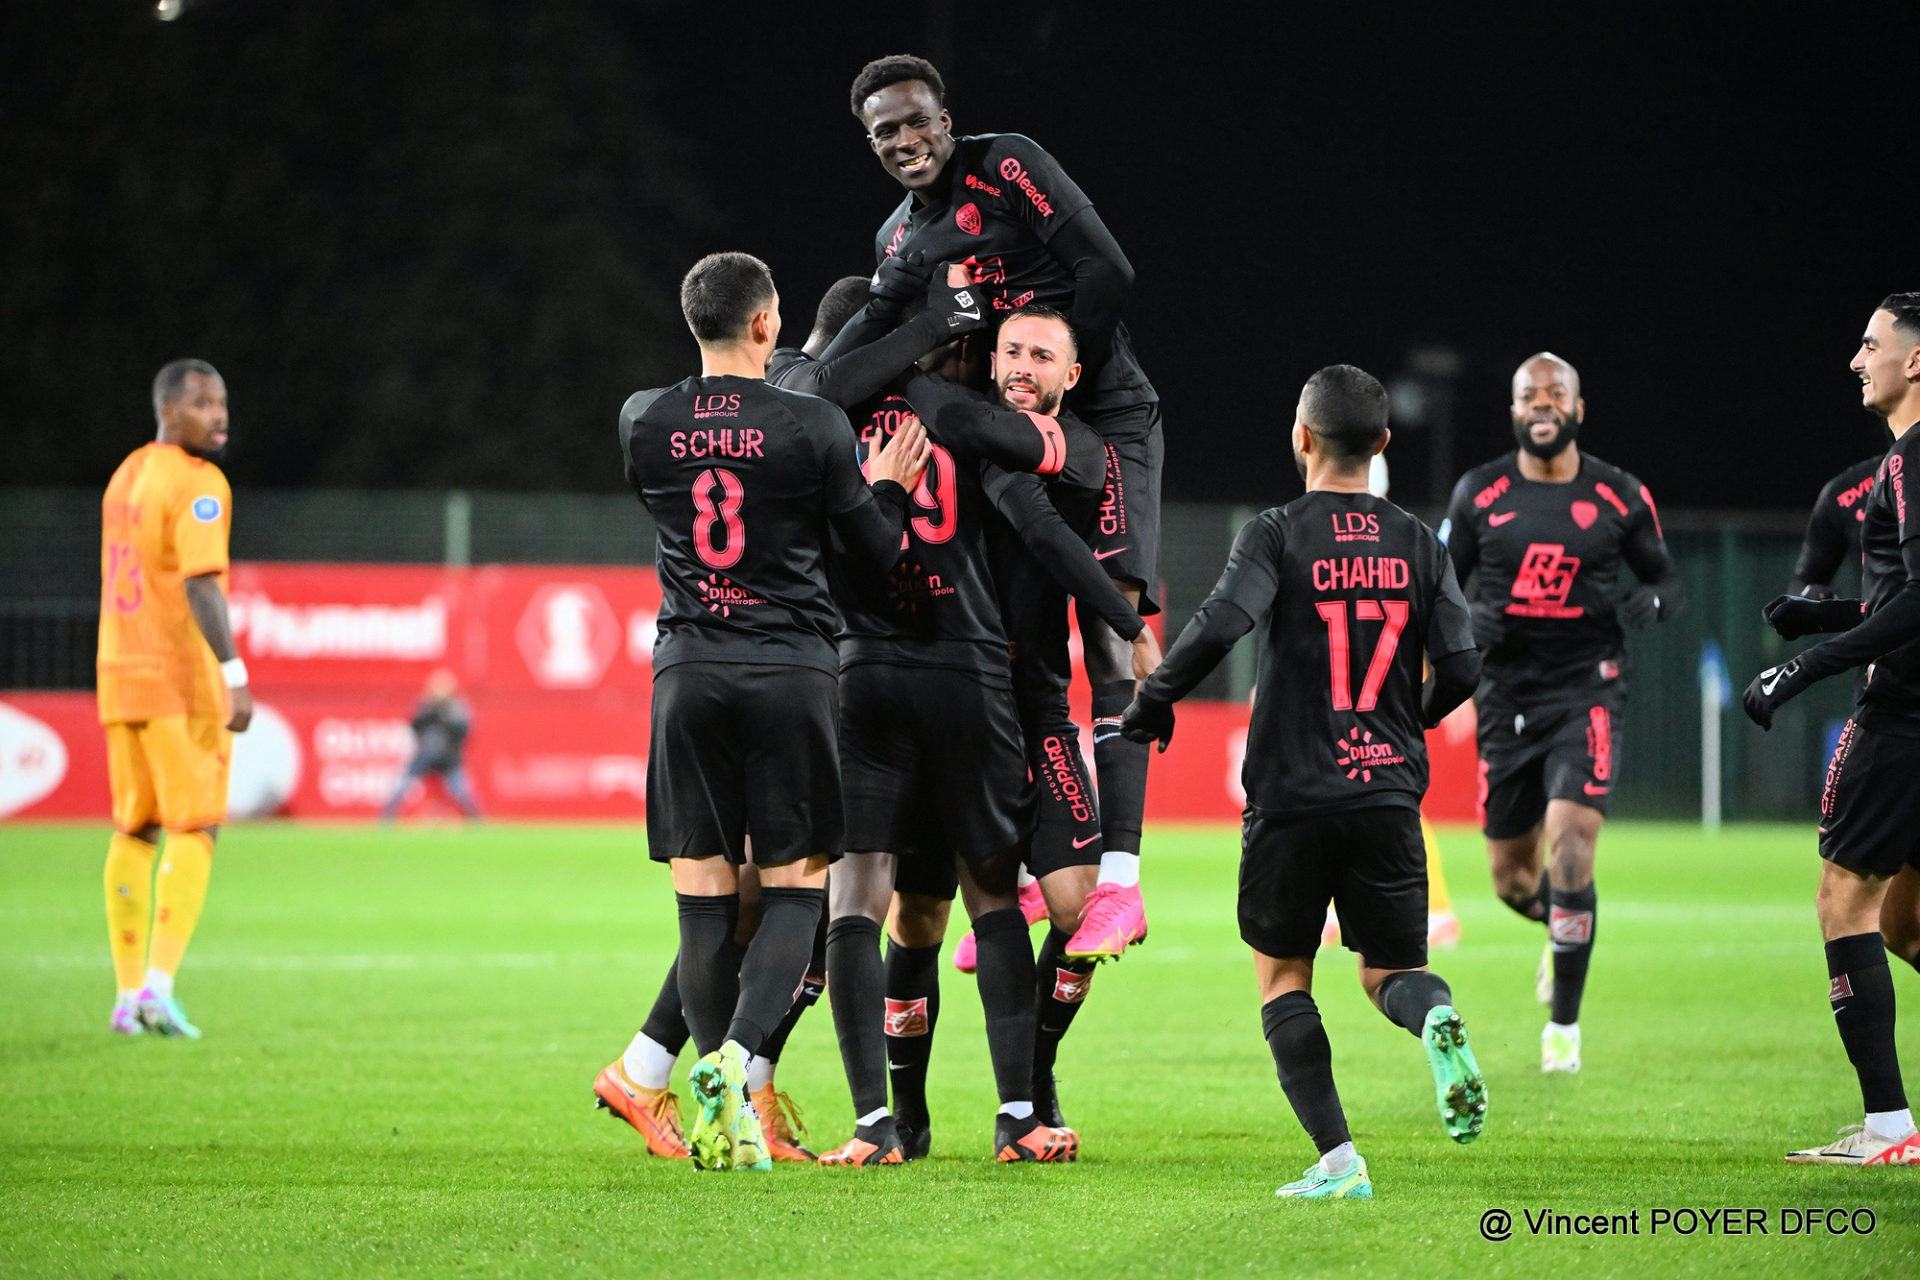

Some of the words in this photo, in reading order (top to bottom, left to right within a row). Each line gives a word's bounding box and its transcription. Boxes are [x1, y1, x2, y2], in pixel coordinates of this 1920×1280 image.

[977, 181, 1001, 197] suez
[1015, 170, 1054, 217] leader
[957, 292, 972, 306] 25
[694, 393, 741, 412] LDS
[670, 428, 764, 458] SCHUR
[691, 468, 745, 569] 8
[1332, 512, 1380, 534] LDS
[107, 543, 143, 615] 13
[1312, 556, 1409, 591] CHAHID
[1315, 600, 1409, 712] 17
[1041, 762, 1062, 801] GROUPE
[1043, 736, 1089, 822] CHOPARD
[1821, 718, 1853, 815] CHOPARD
